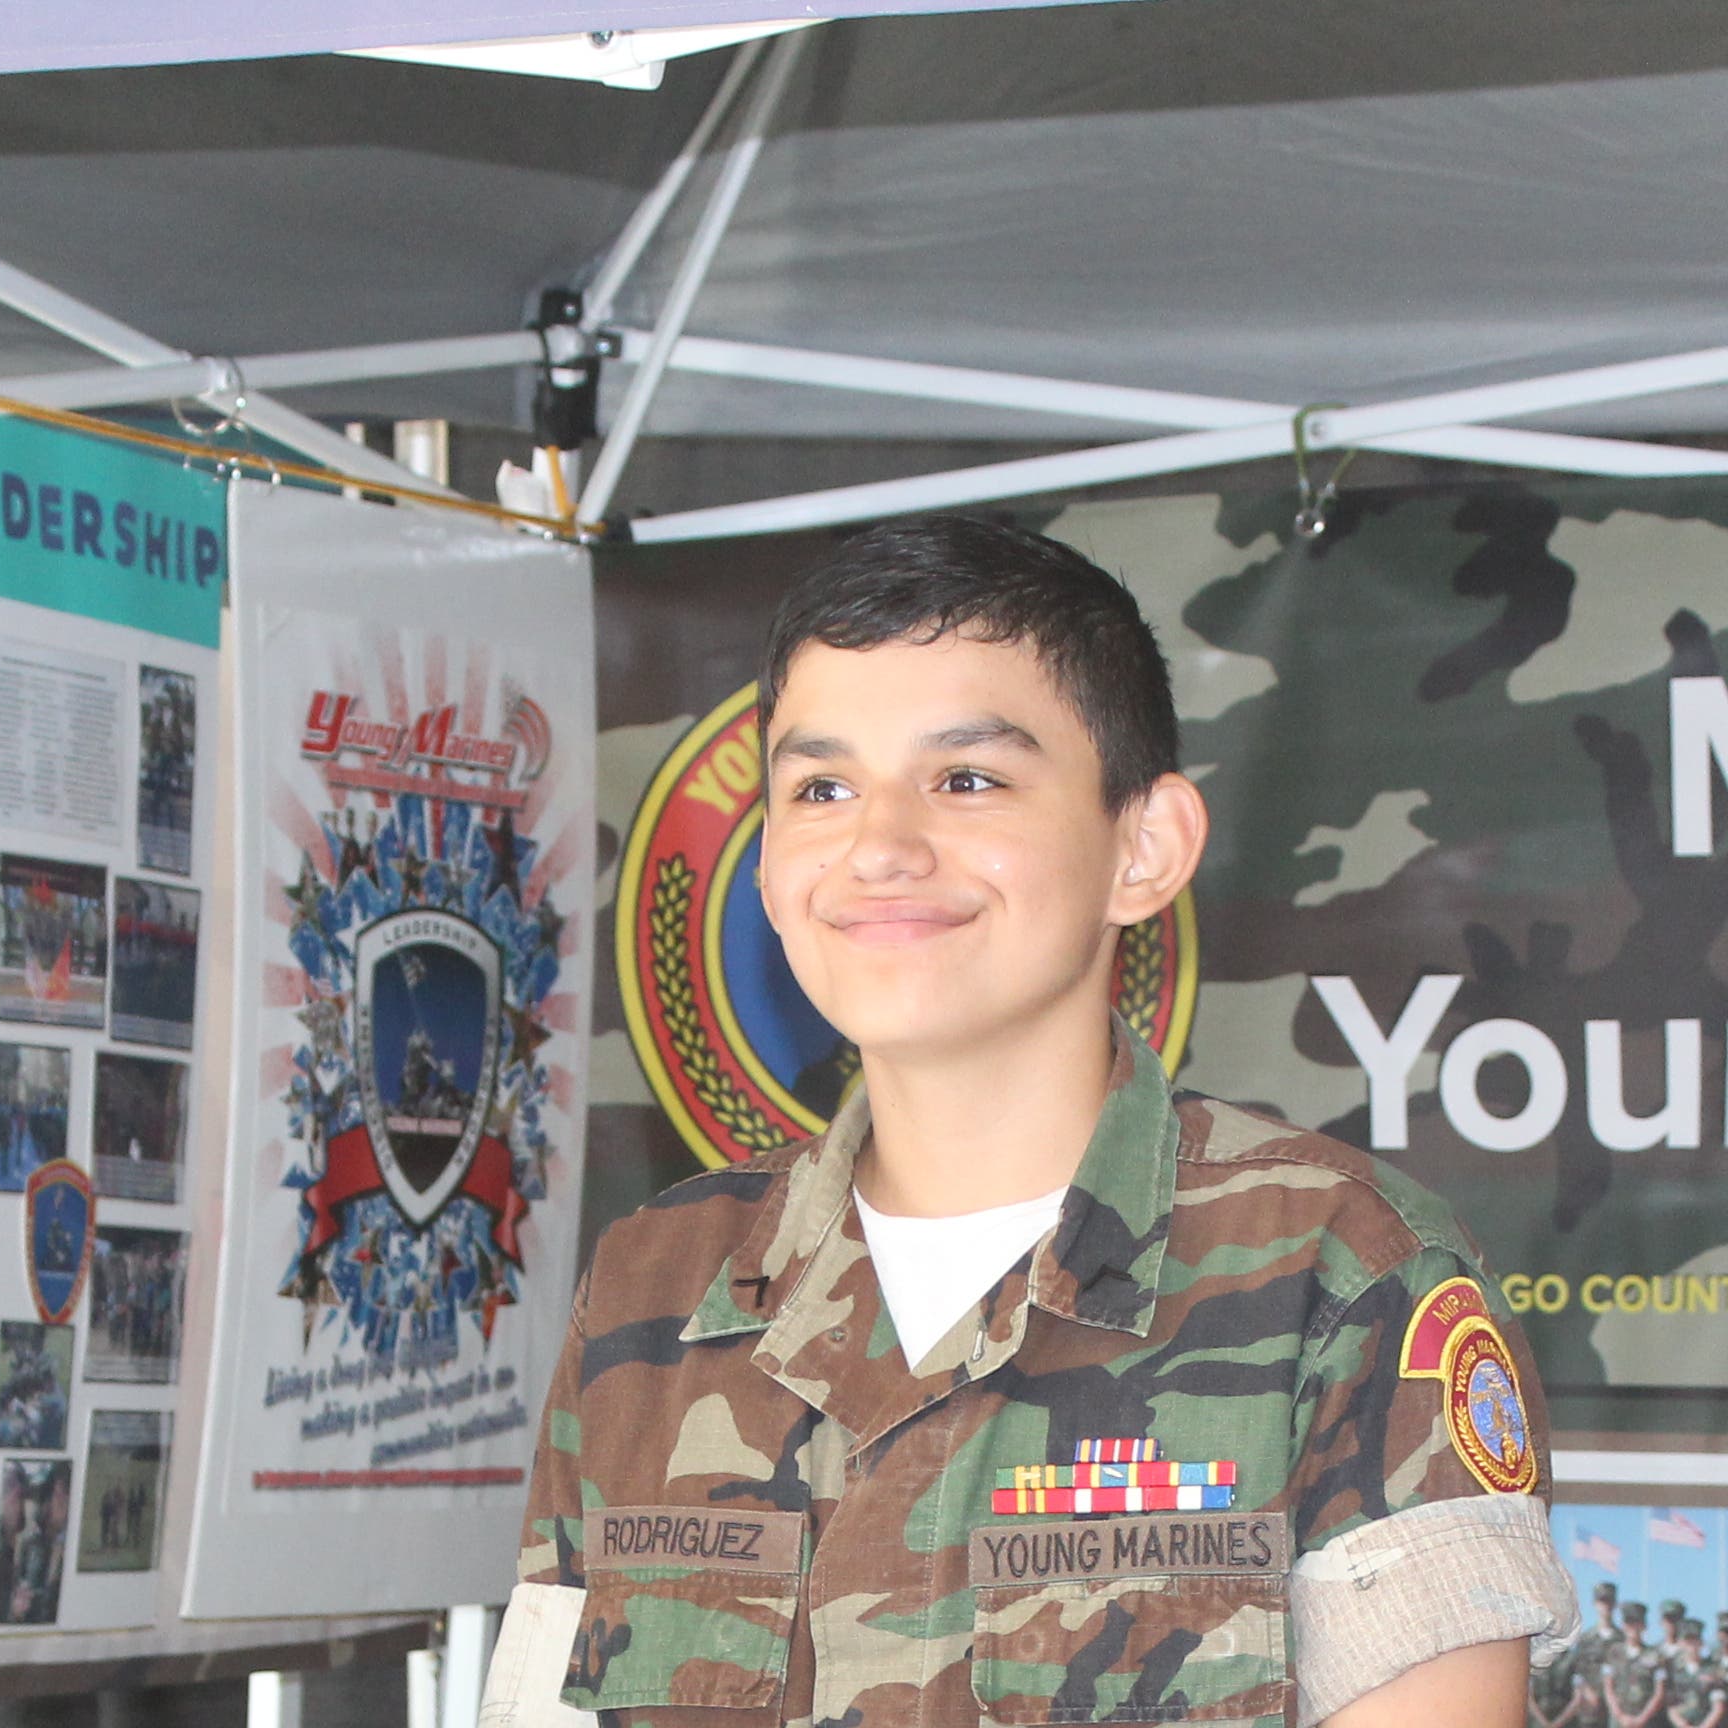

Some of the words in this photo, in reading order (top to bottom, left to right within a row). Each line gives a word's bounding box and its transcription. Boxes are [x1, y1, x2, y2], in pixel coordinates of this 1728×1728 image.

[603, 1517, 763, 1562] RODRIGUEZ
[984, 1529, 1103, 1578] YOUNG
[1112, 1520, 1273, 1570] MARINES
